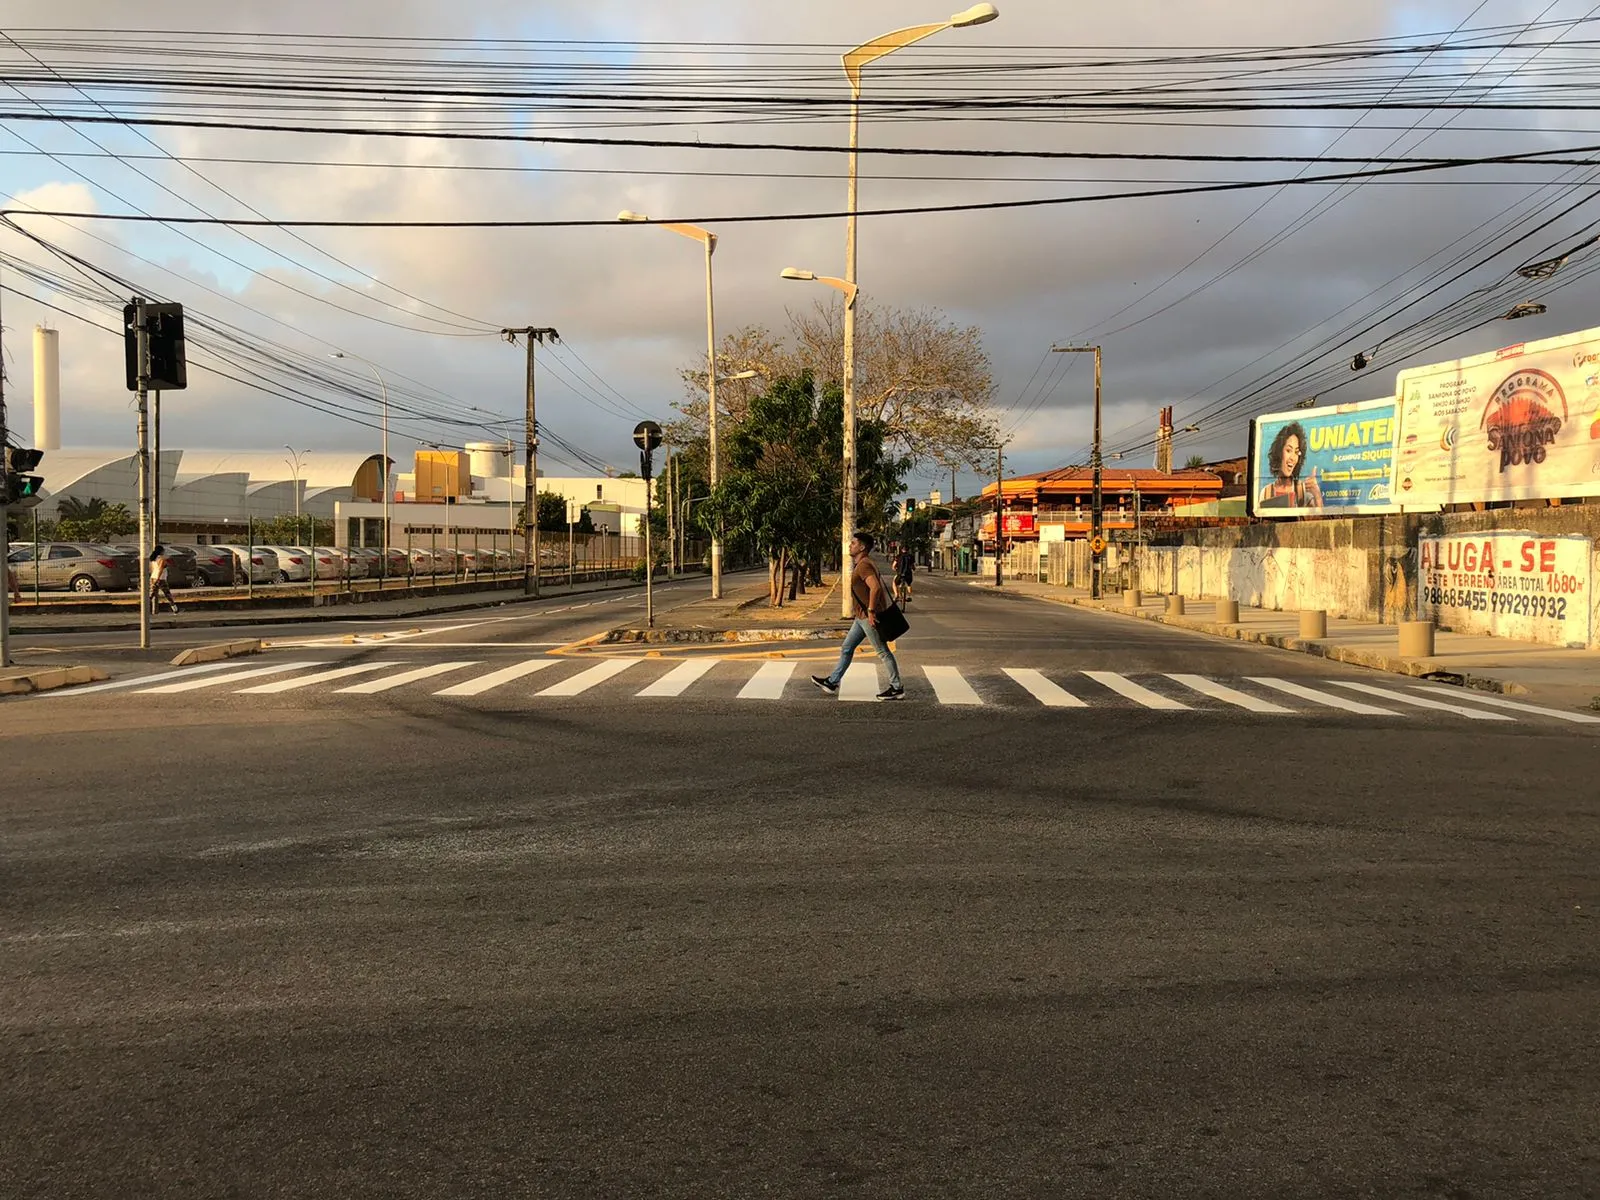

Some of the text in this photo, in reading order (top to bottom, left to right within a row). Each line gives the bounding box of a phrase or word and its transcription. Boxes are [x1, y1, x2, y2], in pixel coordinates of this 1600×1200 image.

[1495, 376, 1554, 405] PROGRAMA
[1421, 541, 1495, 573] ALUGA
[1520, 541, 1556, 573] SE
[1427, 573, 1448, 587] ESTE
[1452, 573, 1496, 589] TERRENO
[1519, 576, 1545, 592] TOTAL
[1424, 586, 1487, 611] 988685455
